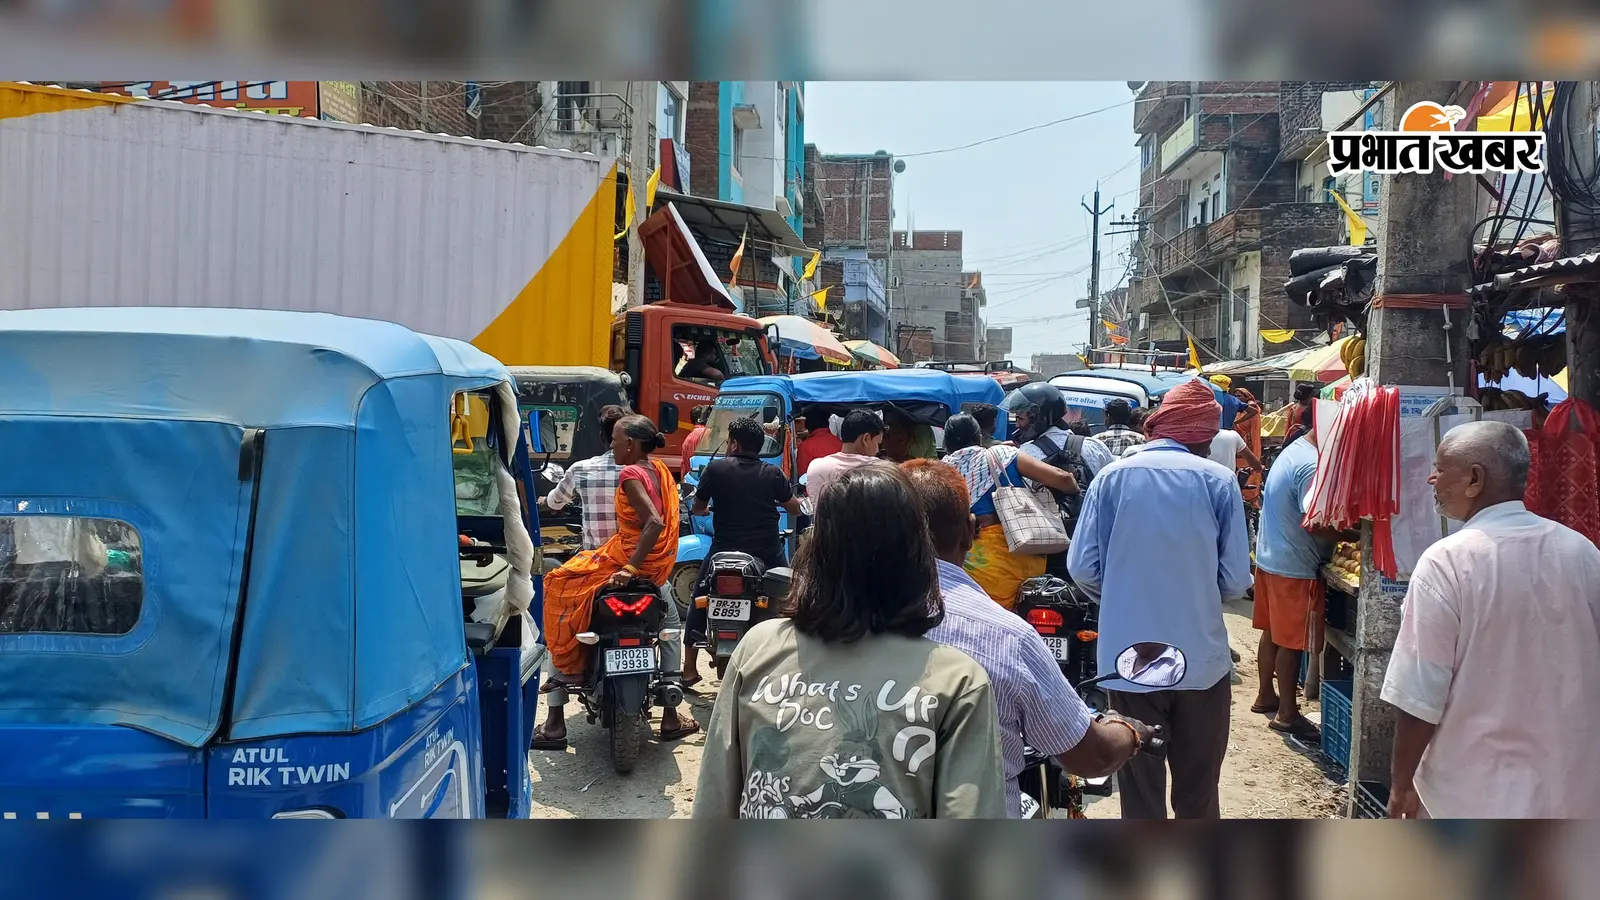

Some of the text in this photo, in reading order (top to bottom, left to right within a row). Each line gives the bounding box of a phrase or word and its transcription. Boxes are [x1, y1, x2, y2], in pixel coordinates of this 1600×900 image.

[686, 394, 711, 402] EICHER
[712, 608, 741, 618] 6893
[1042, 637, 1062, 648] 02B
[614, 649, 649, 661] BR02B
[232, 747, 289, 763] ATUL
[228, 762, 350, 786] RIK TWIN
